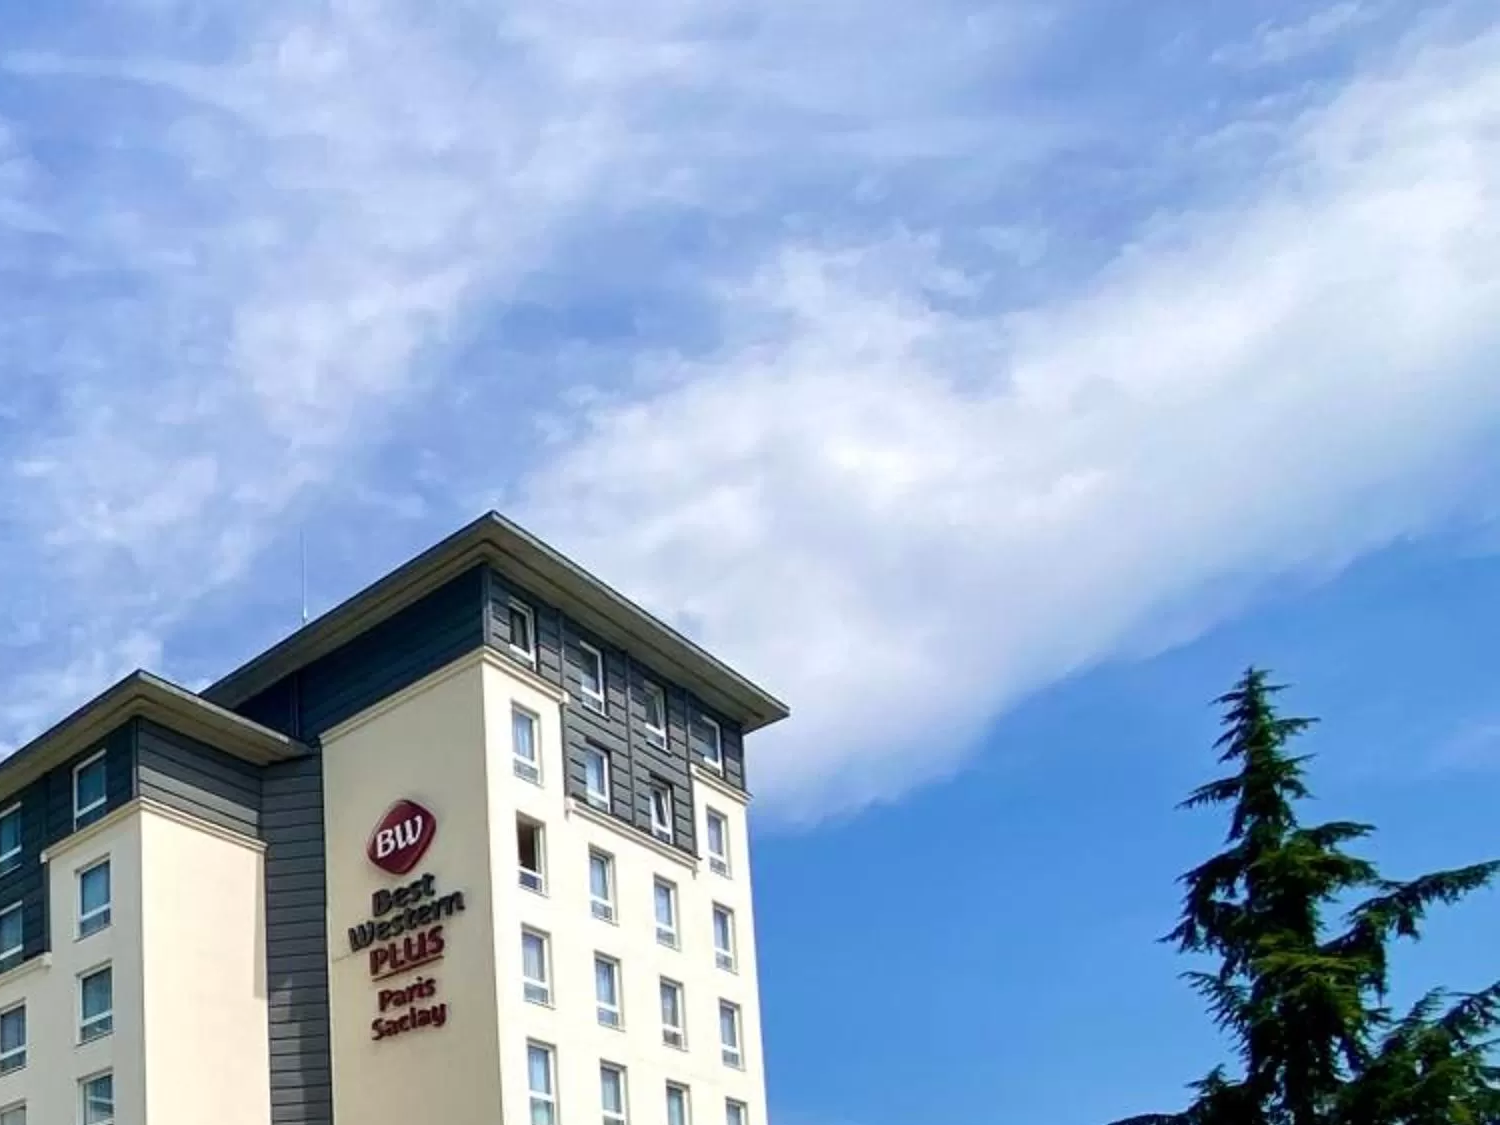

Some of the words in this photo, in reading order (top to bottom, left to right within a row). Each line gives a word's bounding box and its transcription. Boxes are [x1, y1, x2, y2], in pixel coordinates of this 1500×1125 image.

[376, 816, 423, 858] BW
[372, 873, 435, 916] Best
[348, 891, 465, 952] Western
[370, 925, 445, 976] PLUS
[378, 976, 436, 1012] Paris
[372, 1004, 447, 1041] Saclay
